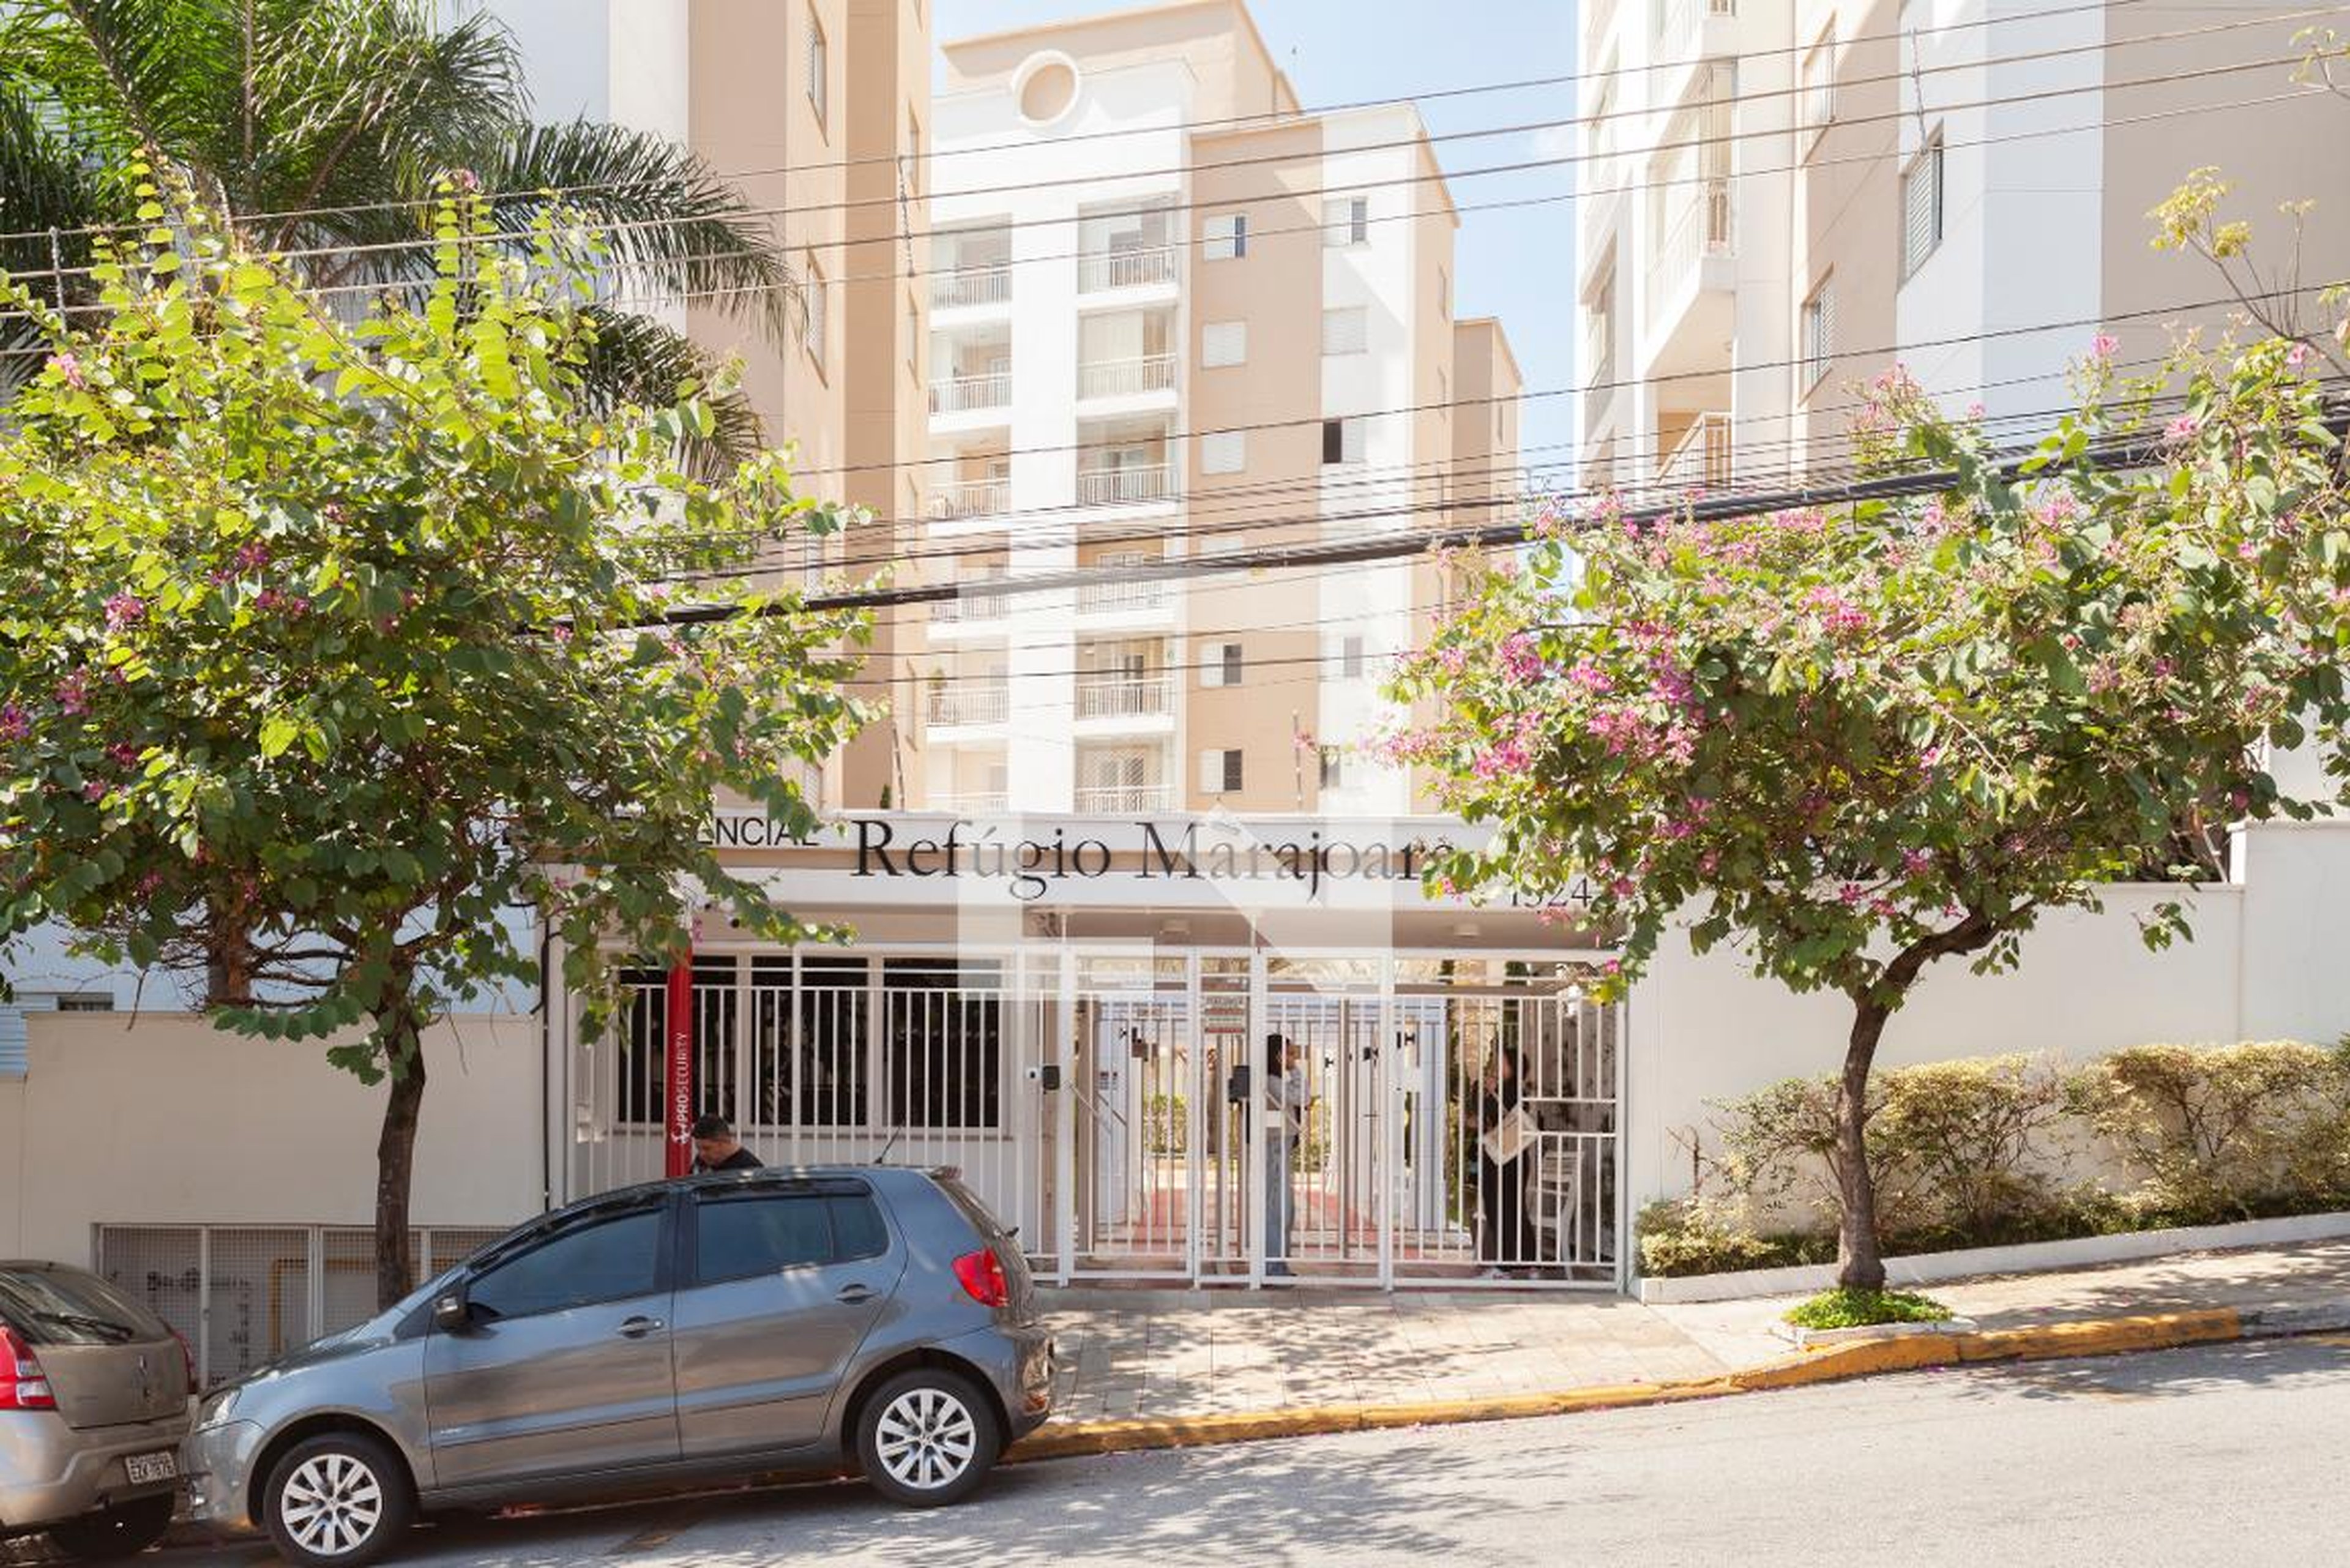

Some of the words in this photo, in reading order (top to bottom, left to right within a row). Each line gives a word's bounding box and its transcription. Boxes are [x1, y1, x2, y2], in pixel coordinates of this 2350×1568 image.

[850, 819, 1111, 901] Refúgio
[1135, 821, 1455, 903] Marajoar
[676, 1032, 689, 1124] PROSECURITY
